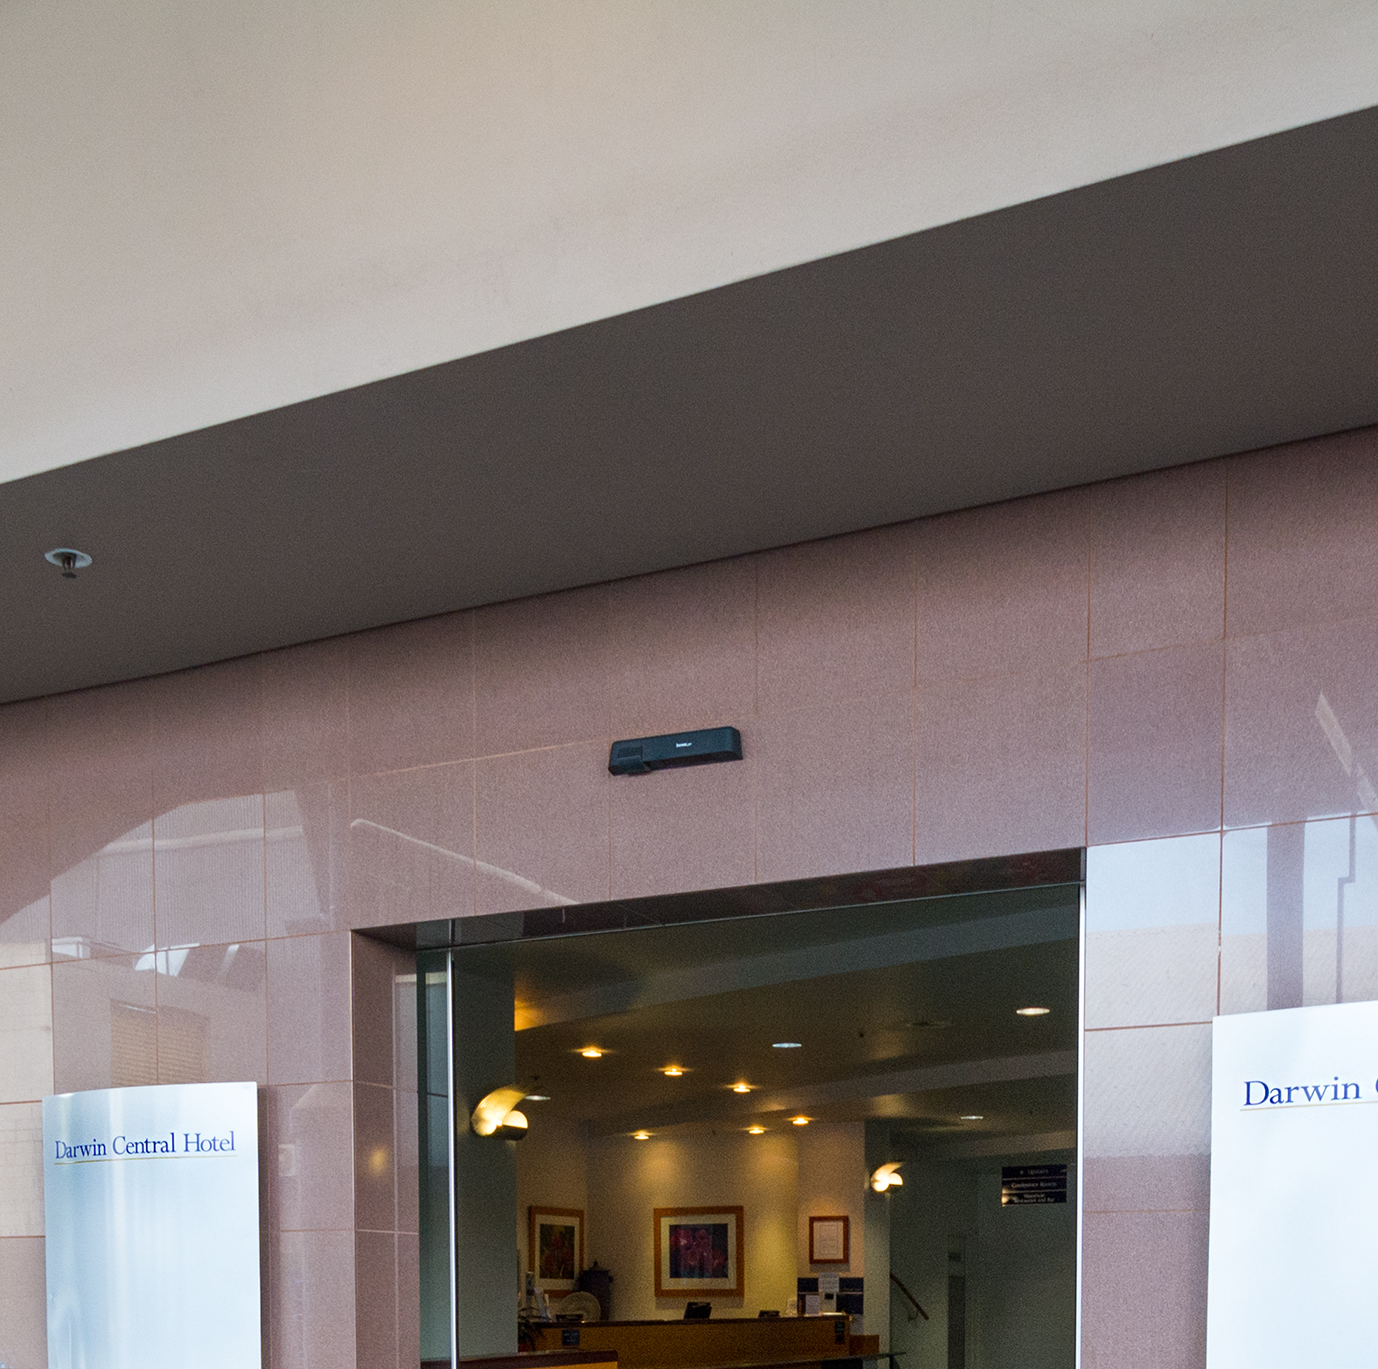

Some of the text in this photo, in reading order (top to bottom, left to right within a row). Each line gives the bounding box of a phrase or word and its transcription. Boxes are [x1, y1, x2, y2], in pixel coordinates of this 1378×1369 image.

[1243, 1075, 1363, 1107] Darwin
[55, 1130, 237, 1160] Darwin Central Hotel
